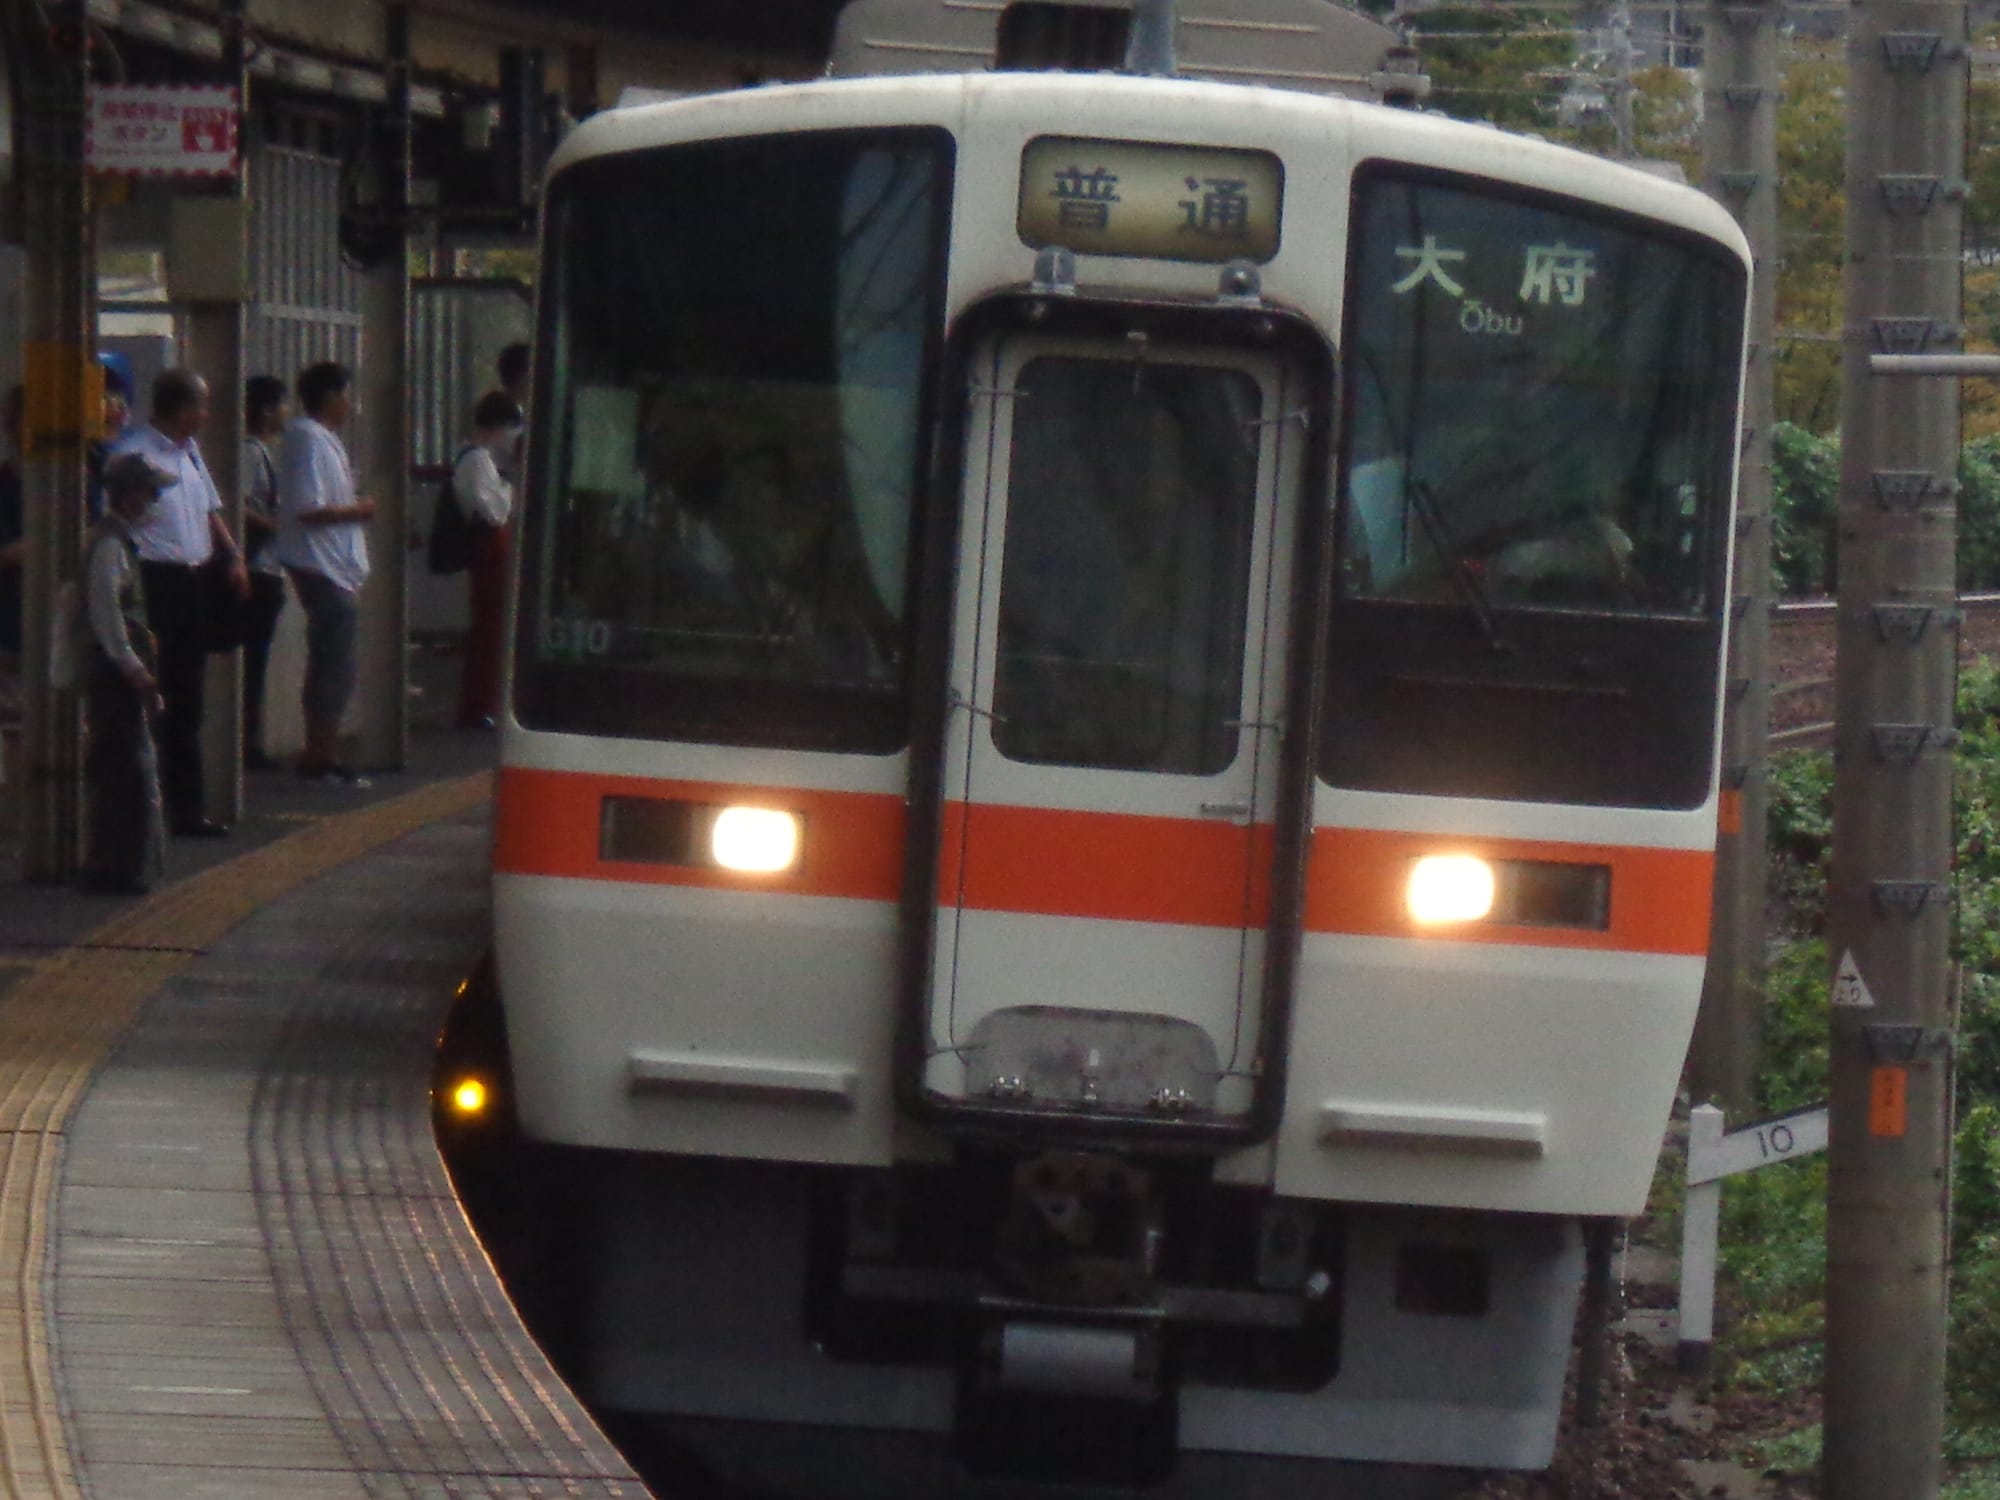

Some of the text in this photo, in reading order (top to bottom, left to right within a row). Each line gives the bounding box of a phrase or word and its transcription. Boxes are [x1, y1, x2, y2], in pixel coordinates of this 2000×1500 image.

[1050, 165, 1249, 240] 普通
[1392, 235, 1596, 304] 大府
[1460, 300, 1522, 334] Ōbu
[1757, 1125, 1794, 1158] 10
